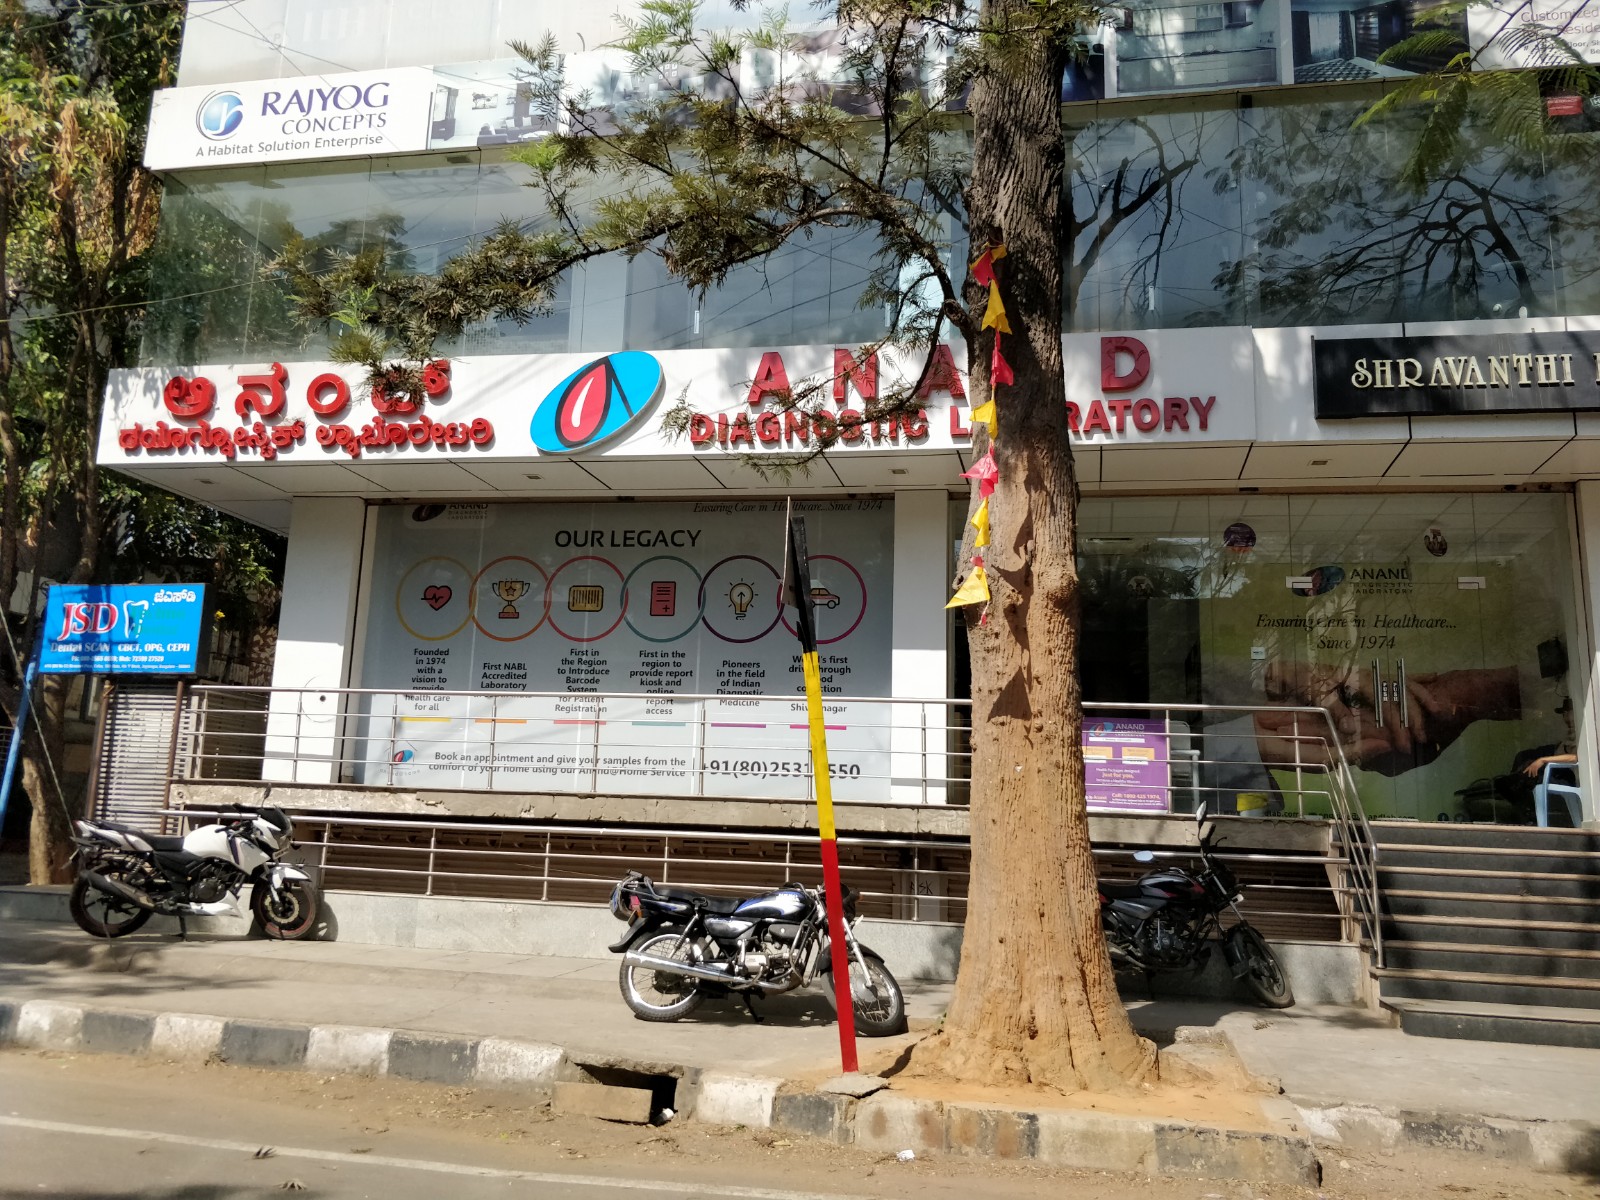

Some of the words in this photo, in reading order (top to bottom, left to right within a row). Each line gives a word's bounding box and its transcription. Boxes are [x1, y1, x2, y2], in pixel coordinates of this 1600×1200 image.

[1521, 7, 1599, 23] Customzed
[261, 82, 390, 117] RAJYOG
[282, 113, 388, 135] CONCEPTS
[195, 148, 205, 157] A
[207, 143, 254, 157] Habitat
[258, 140, 311, 154] Solution
[315, 134, 383, 149] Enterprise
[1351, 353, 1575, 389] SHRAVANTHI
[950, 396, 1216, 438] LRATORY
[693, 502, 732, 514] Ensuring
[735, 502, 756, 512] Care
[857, 500, 883, 511] 1974
[555, 530, 604, 547] OUR
[610, 529, 701, 547] LEGACY
[57, 602, 119, 641] JSD
[1256, 614, 1314, 631] Ensuring
[1360, 636, 1395, 649] 1974
[414, 648, 449, 656] Founded
[639, 650, 659, 658] First
[661, 650, 670, 658] in
[672, 650, 686, 658] the
[561, 658, 575, 666] the
[577, 658, 607, 667] Region
[642, 660, 668, 669] region
[722, 660, 761, 669] Pioneers
[569, 667, 610, 675] Introduce
[629, 669, 663, 678] provide
[665, 670, 693, 678] report
[716, 670, 725, 678] in
[727, 670, 742, 678] the
[744, 670, 766, 679] field
[411, 675, 436, 683] vision
[482, 672, 527, 680] Accredited
[481, 681, 527, 690] Laboratory
[720, 679, 731, 687] of
[732, 680, 761, 688] Indian
[797, 685, 842, 693] cotion
[414, 703, 427, 711] for
[429, 703, 439, 711] all
[435, 752, 458, 761] Book
[536, 754, 553, 763] and
[556, 755, 576, 765] give
[603, 757, 641, 767] samples
[644, 757, 667, 766] from
[669, 757, 686, 767] the
